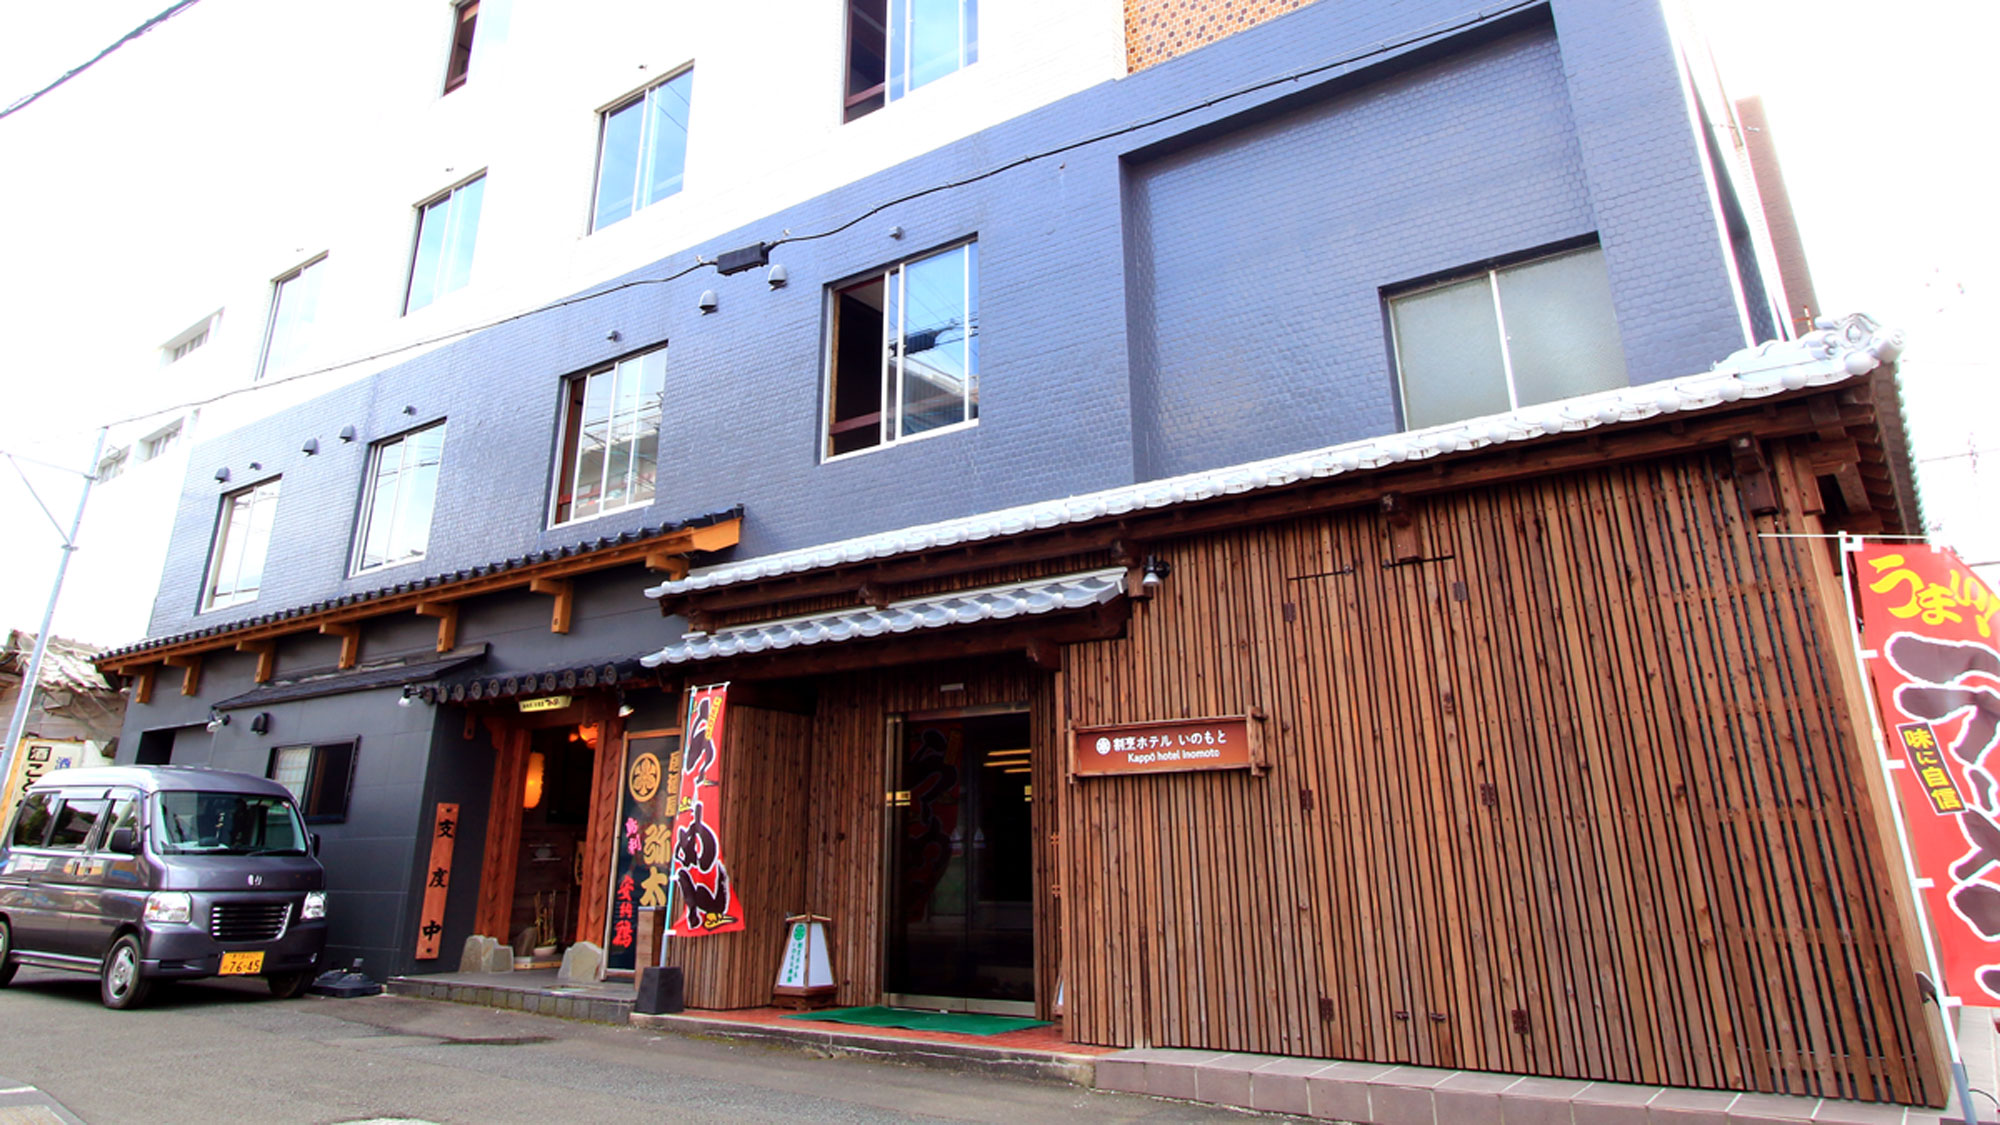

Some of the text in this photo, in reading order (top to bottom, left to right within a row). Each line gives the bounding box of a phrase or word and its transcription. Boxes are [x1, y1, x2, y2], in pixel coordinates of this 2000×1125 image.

[1112, 729, 1227, 752] 割烹ホテル いのもと
[1157, 749, 1180, 761] hotel
[1182, 748, 1220, 759] Inomoto
[1902, 727, 1962, 811] 味に自信
[422, 818, 456, 941] 支度中
